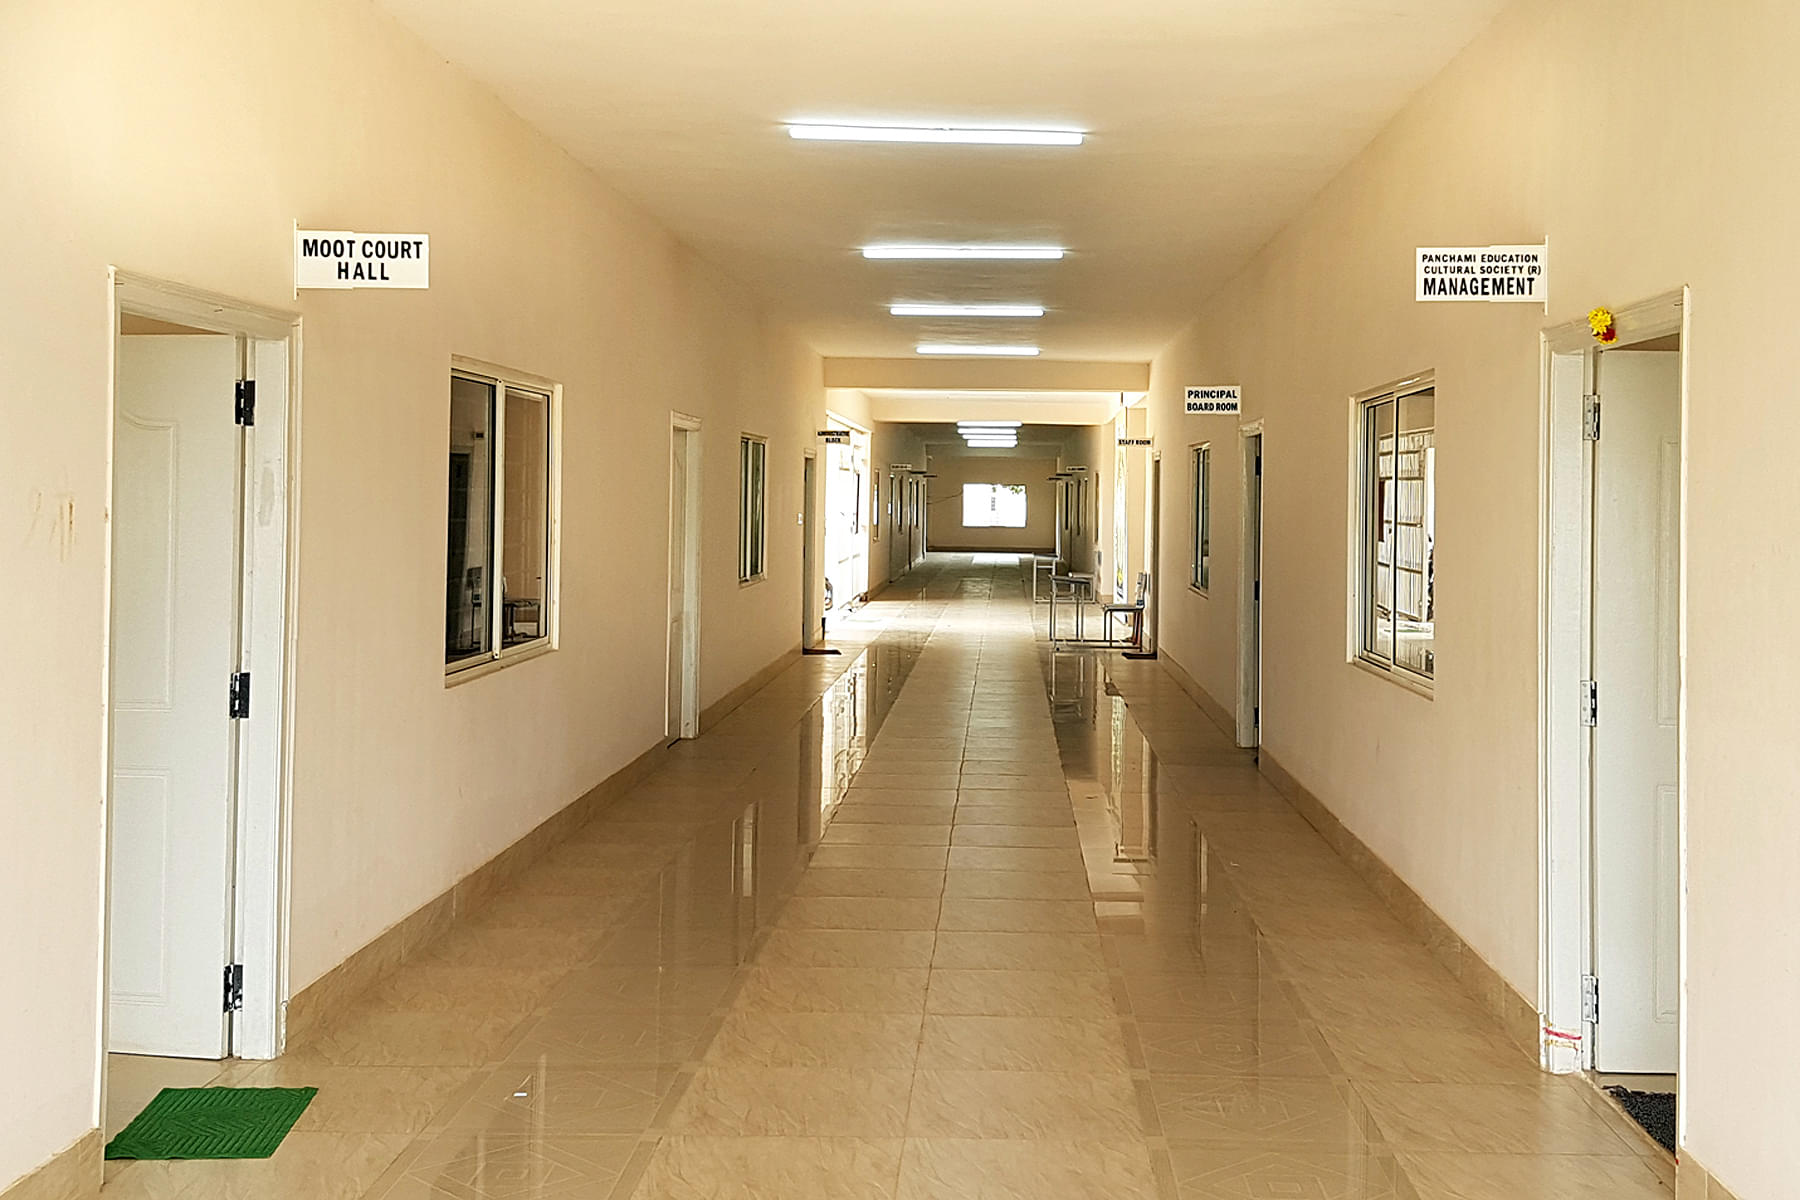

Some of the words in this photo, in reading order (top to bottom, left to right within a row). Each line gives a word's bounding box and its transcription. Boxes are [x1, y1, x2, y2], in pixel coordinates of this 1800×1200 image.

[303, 239, 355, 258] MOOT
[362, 240, 423, 259] COURT
[1422, 254, 1476, 263] PANCHAMI
[1481, 254, 1538, 263] EDUCATION
[338, 261, 389, 280] HALL
[1424, 265, 1476, 274] CULTURAL
[1480, 265, 1524, 275] SOCIETY
[1528, 265, 1542, 275] (R)
[1423, 277, 1535, 296] MANAGEMENT
[1187, 390, 1238, 399] PRINCIPAL
[1187, 402, 1215, 411] BOARD
[1216, 402, 1238, 411] ROOM
